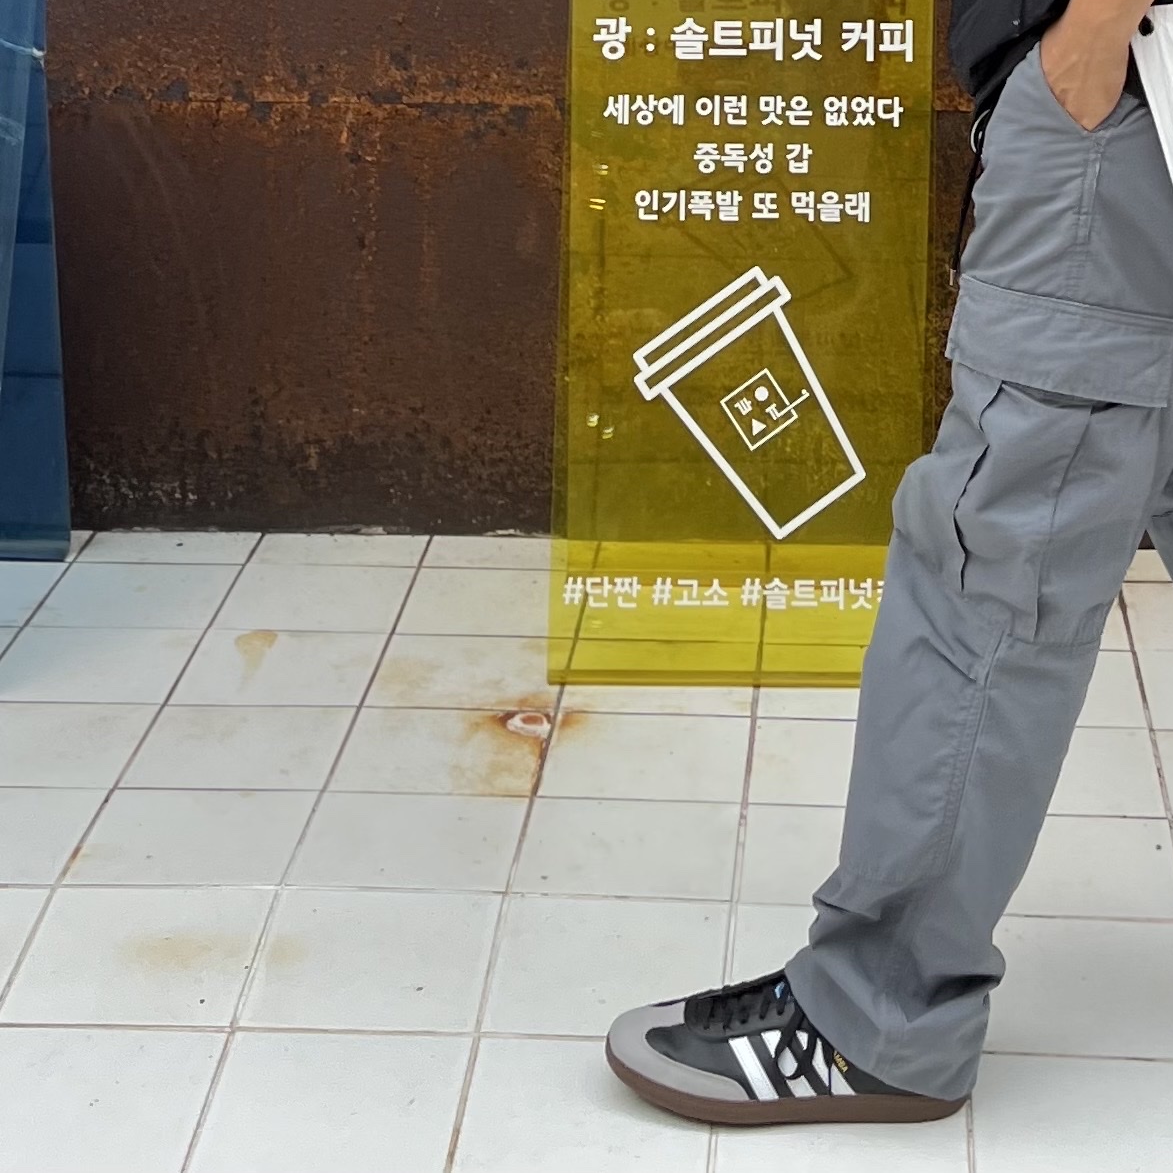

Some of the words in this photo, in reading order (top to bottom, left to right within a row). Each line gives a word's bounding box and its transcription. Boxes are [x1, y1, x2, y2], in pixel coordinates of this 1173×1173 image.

[593, 17, 633, 60] 광
[670, 17, 824, 62] 솔트피넛
[841, 19, 915, 63] 커피
[603, 94, 686, 126] 세상에
[695, 94, 749, 127] 이런
[759, 95, 814, 127] 맛은
[823, 96, 904, 128] 없었다
[693, 143, 775, 175] 중독성
[785, 143, 813, 175] 갑
[634, 189, 743, 222] 인기폭발
[751, 192, 780, 220] 또
[791, 190, 872, 224] 먹을래
[563, 576, 642, 610] #단짠
[652, 578, 731, 608] #고소
[741, 577, 885, 611] #솔트피넛
